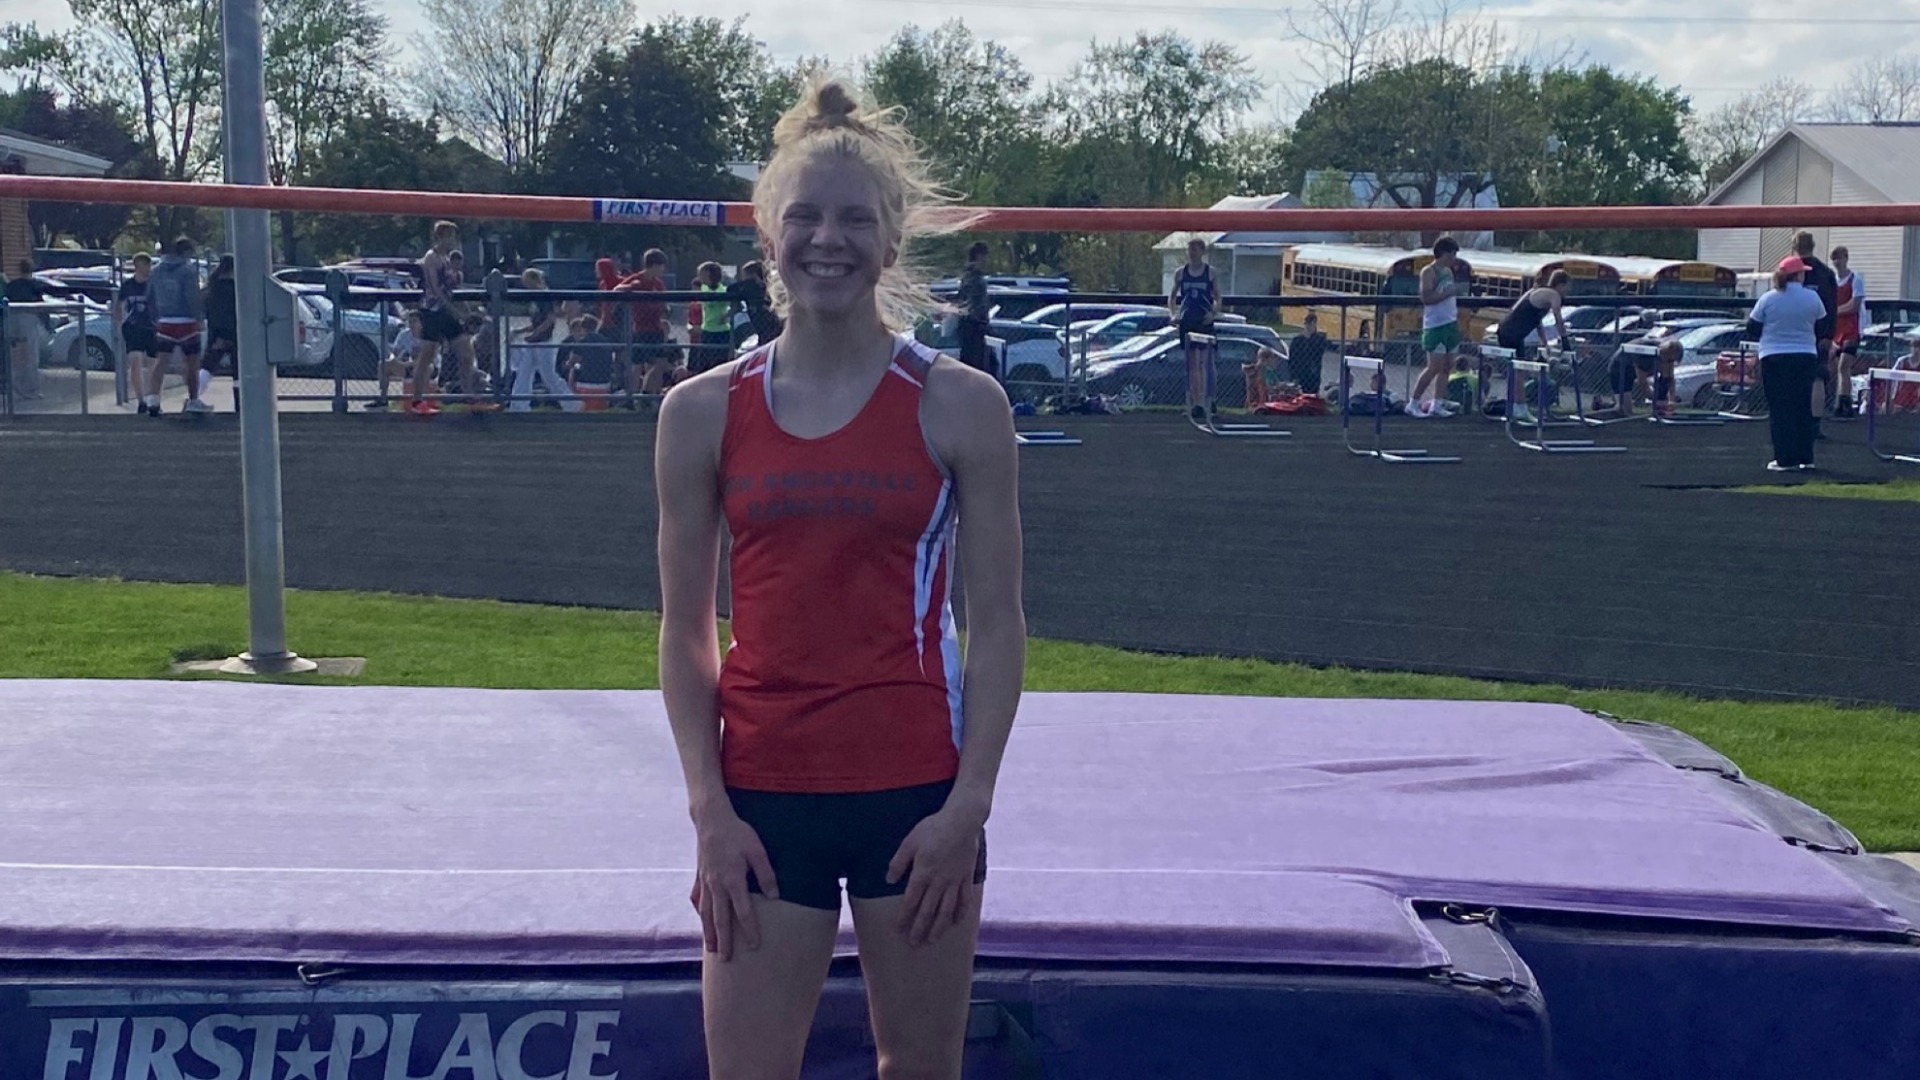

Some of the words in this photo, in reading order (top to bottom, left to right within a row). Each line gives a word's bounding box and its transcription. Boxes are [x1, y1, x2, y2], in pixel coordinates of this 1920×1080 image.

[606, 201, 655, 215] FIRST
[659, 203, 712, 218] PLACE
[44, 1014, 297, 1080] FIRST
[328, 1010, 621, 1080] PLACE
